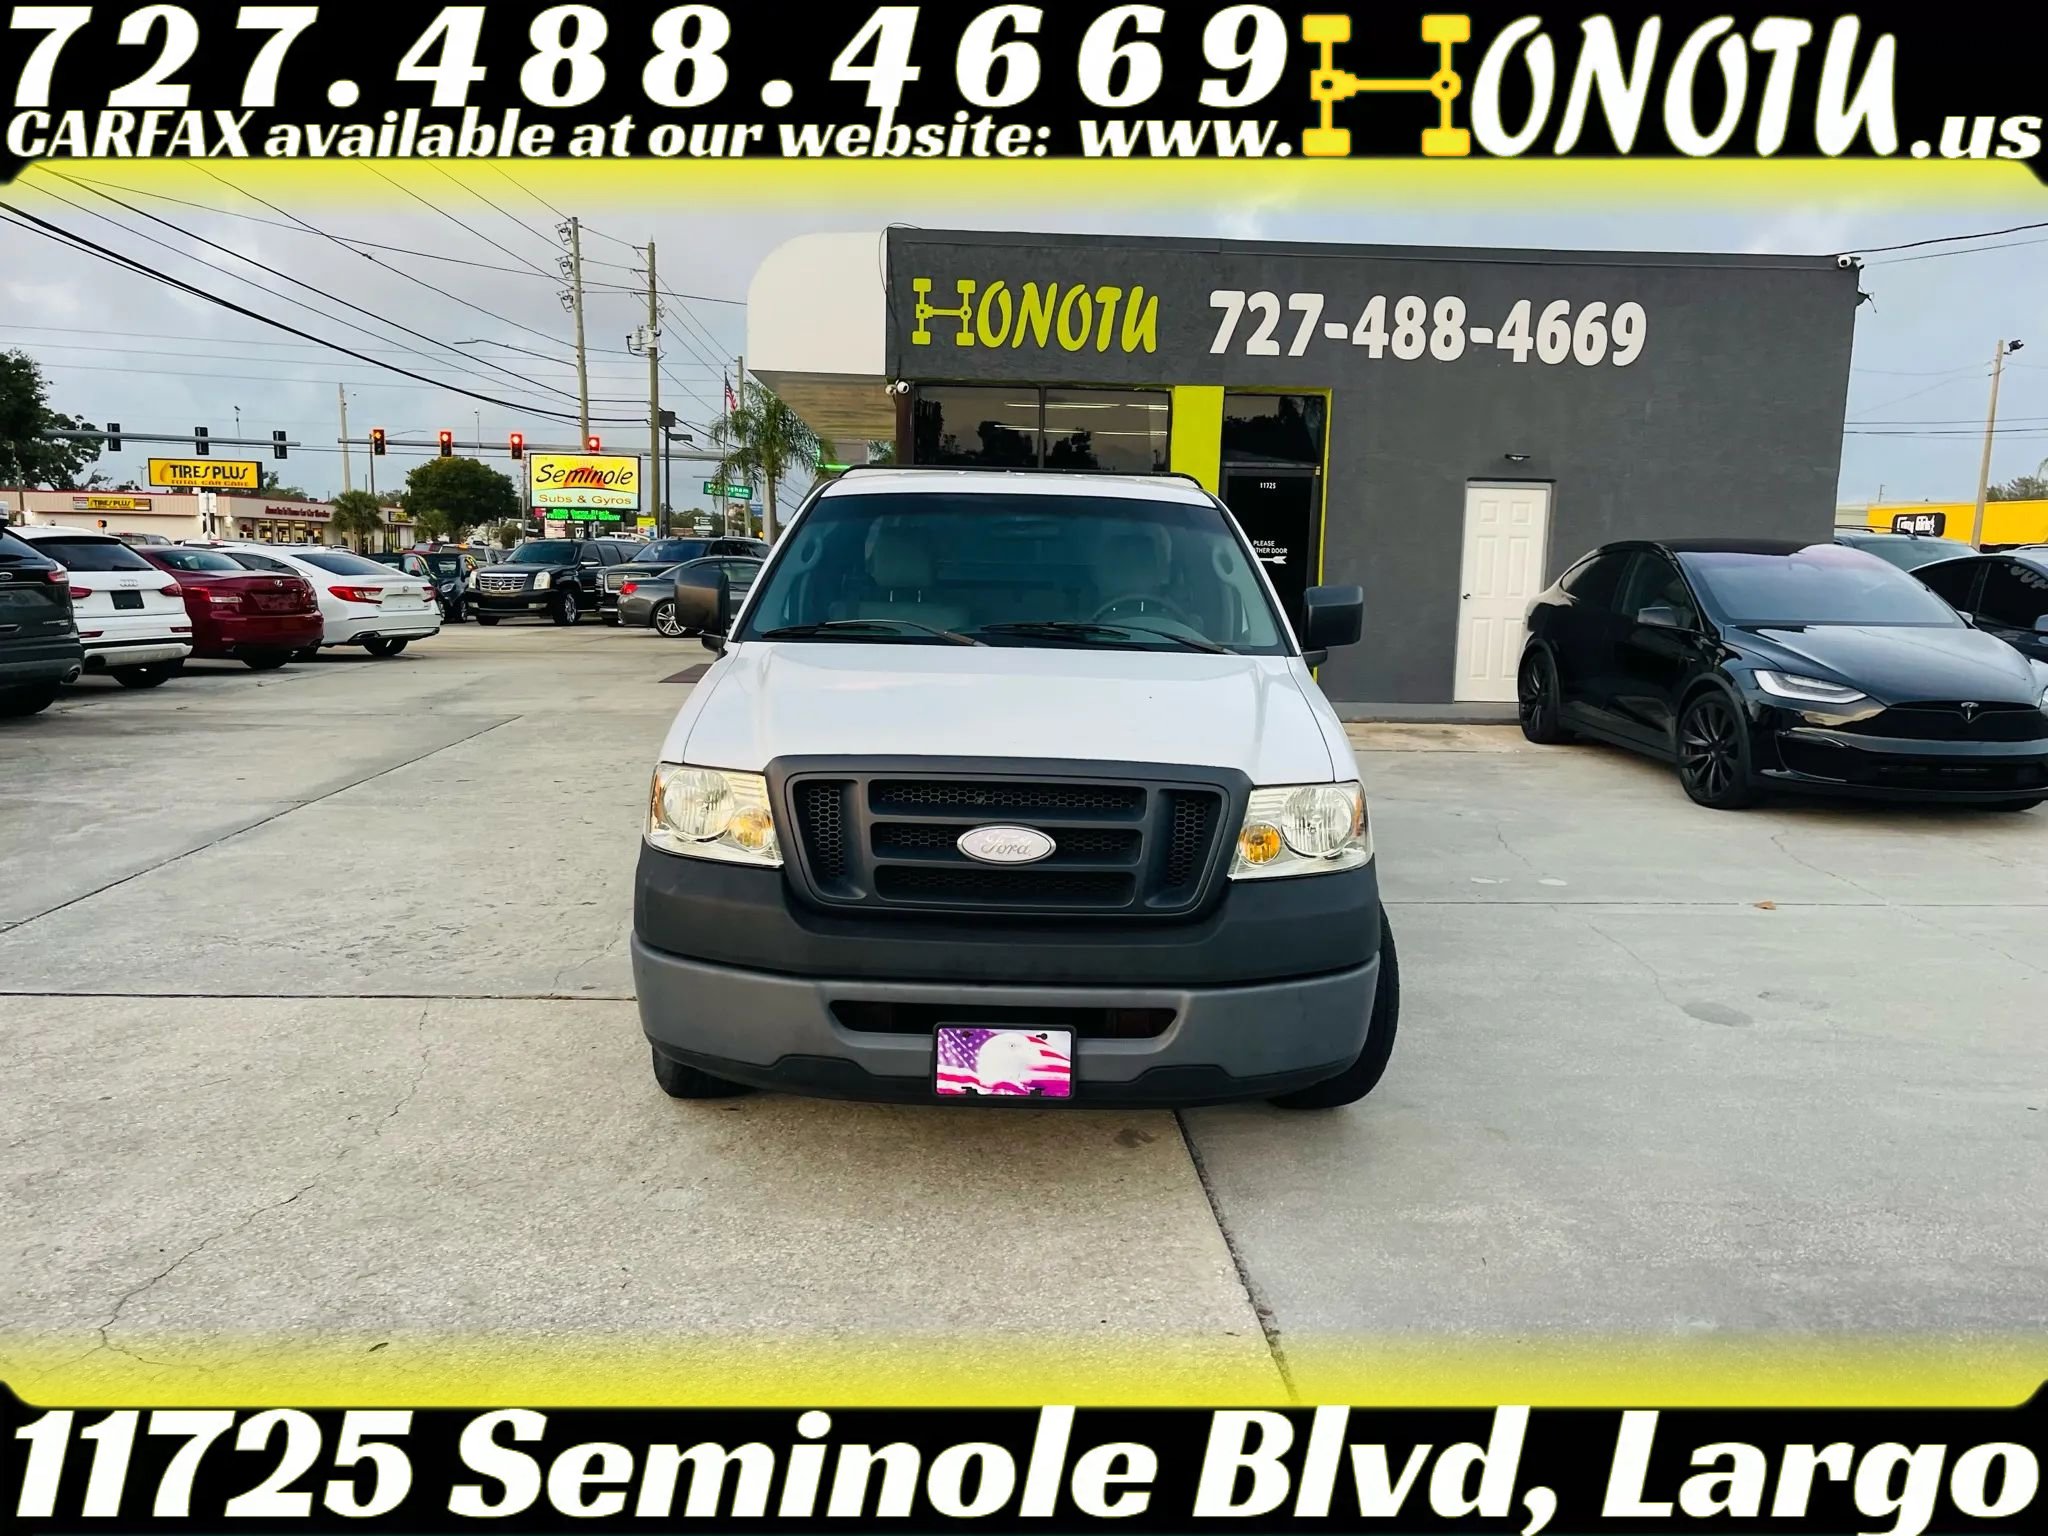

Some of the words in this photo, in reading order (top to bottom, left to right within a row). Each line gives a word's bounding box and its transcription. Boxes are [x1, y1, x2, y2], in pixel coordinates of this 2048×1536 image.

[1209, 290, 1648, 366] 727-488-4669
[535, 463, 634, 486] Seminole
[538, 494, 573, 504] Subs
[577, 494, 587, 503] &
[591, 494, 632, 506] Gyros
